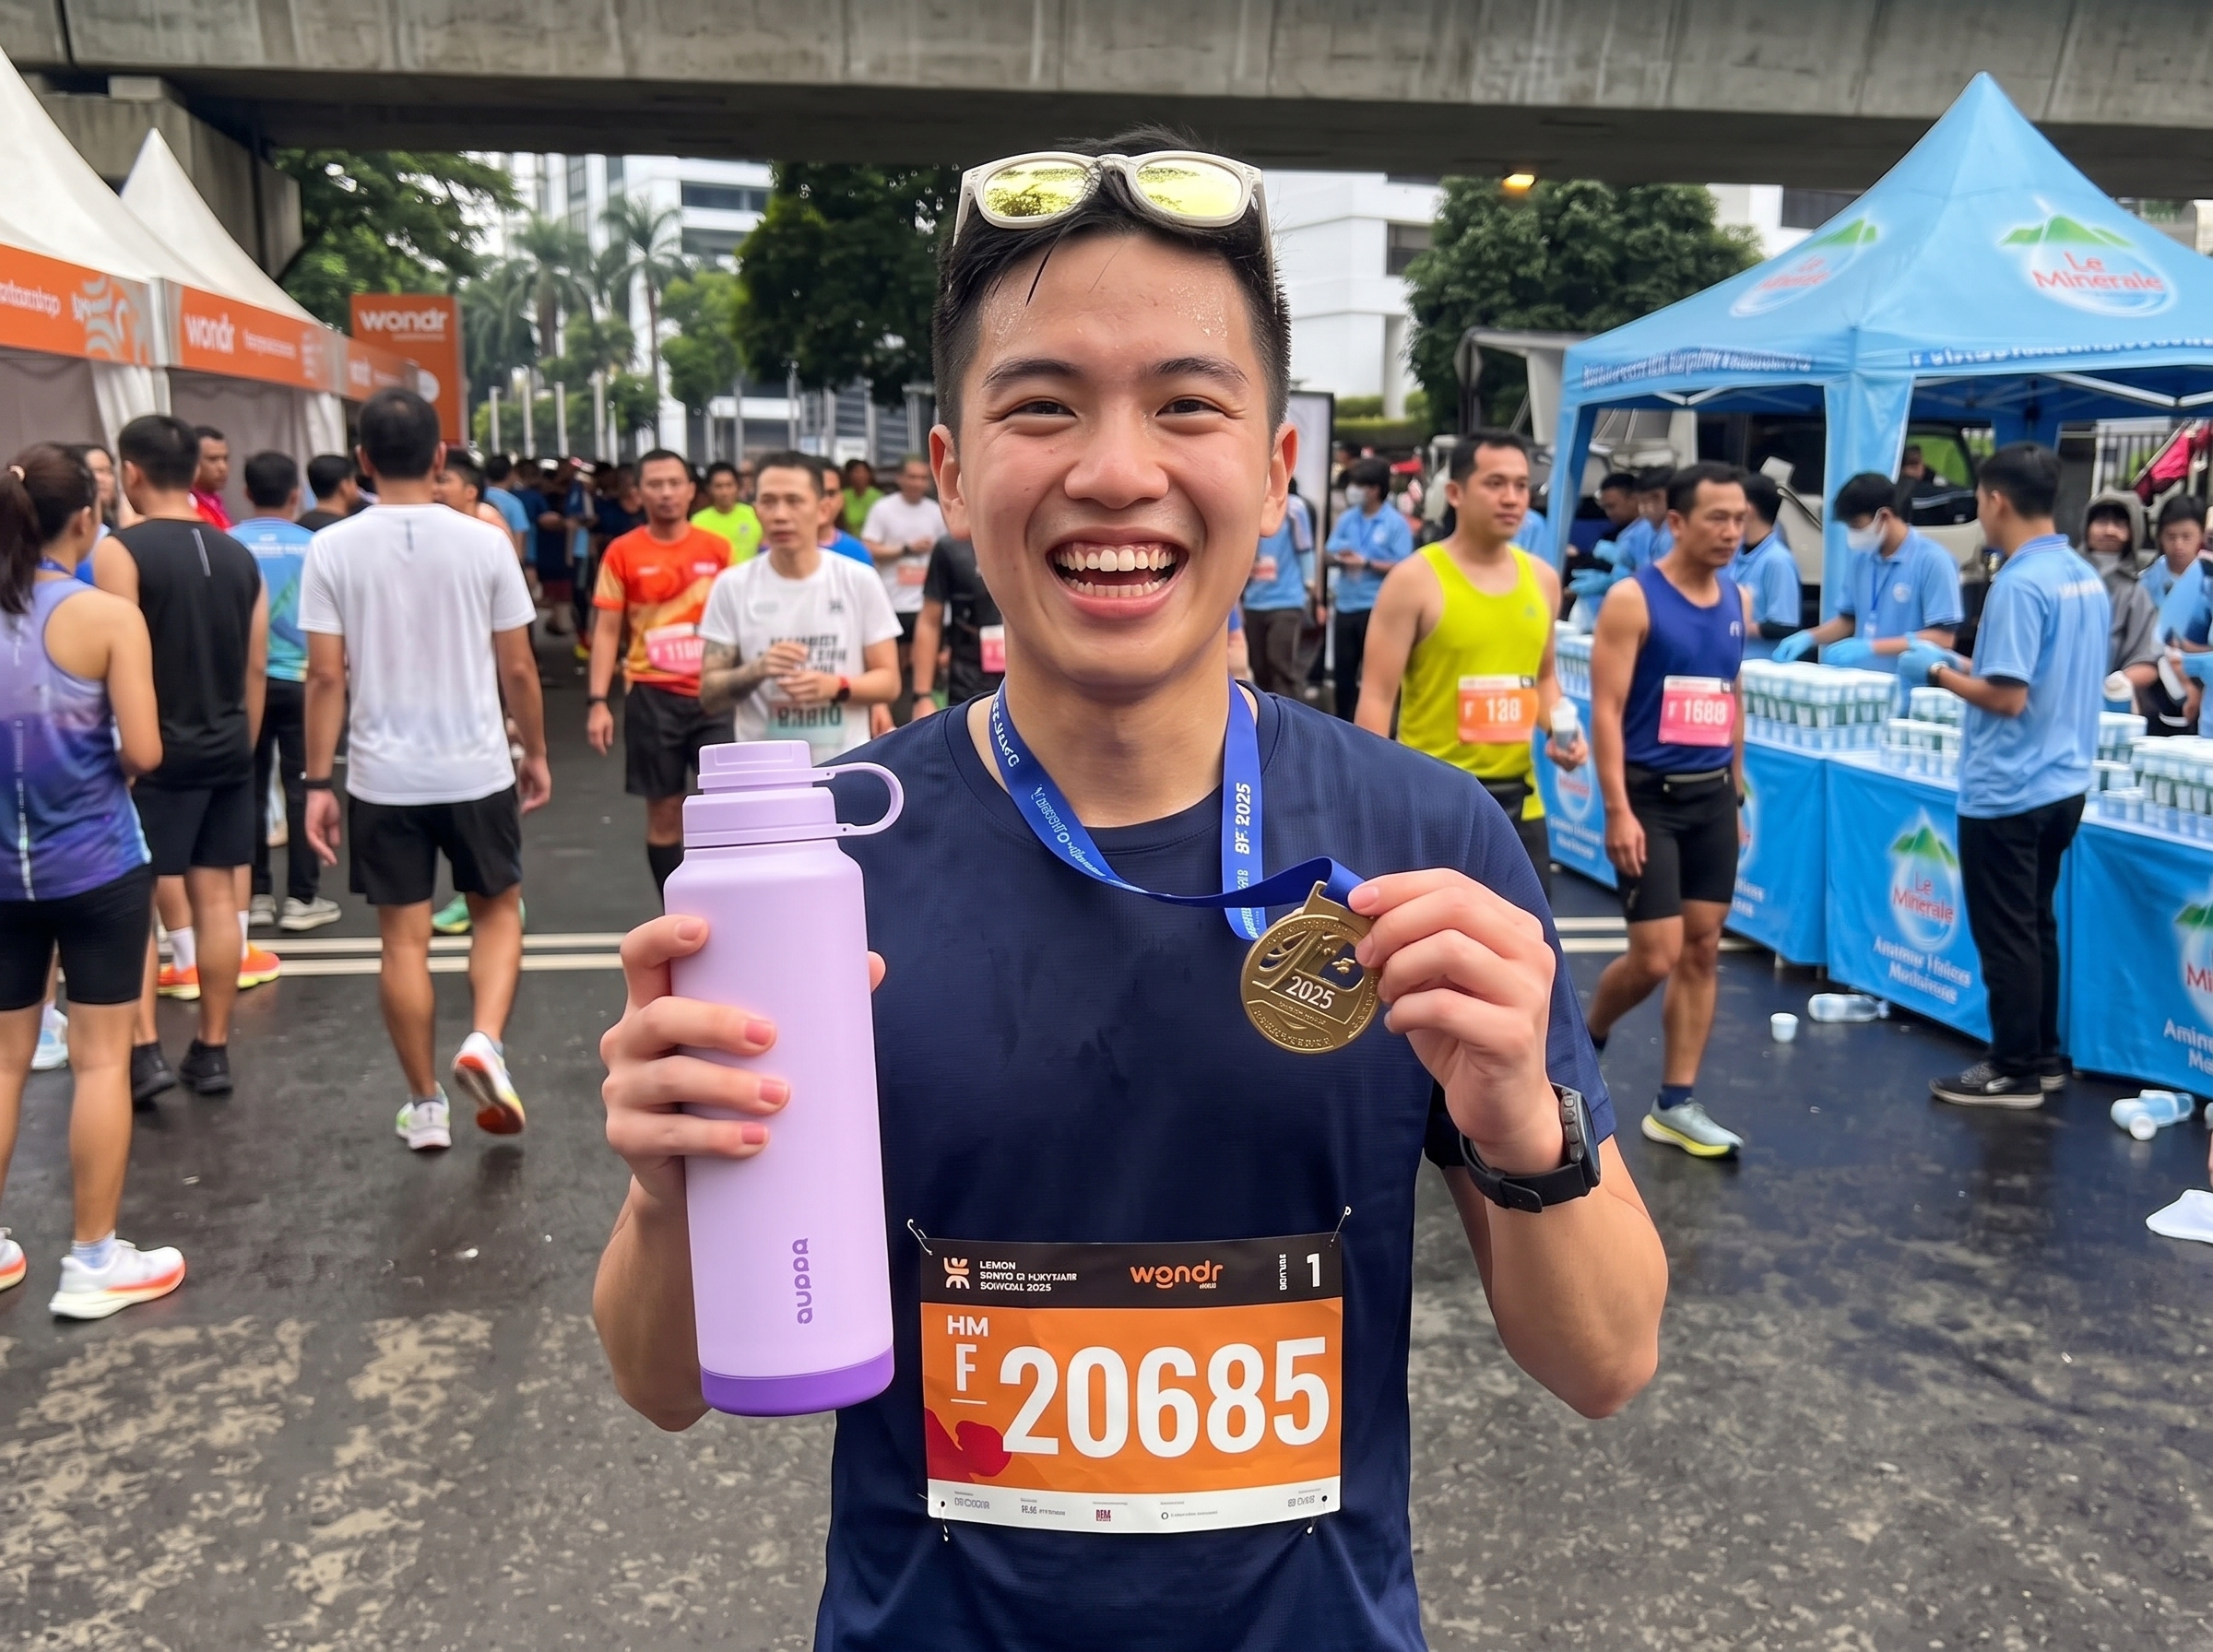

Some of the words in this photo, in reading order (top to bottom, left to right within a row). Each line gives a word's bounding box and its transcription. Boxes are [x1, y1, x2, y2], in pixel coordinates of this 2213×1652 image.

[2064, 251, 2104, 272] Le
[2033, 270, 2163, 291] Minerale
[358, 307, 449, 332] wondr
[1236, 783, 1250, 827] 2025
[1915, 870, 1932, 895] Le
[1893, 887, 1954, 924] Minerale
[1285, 975, 1336, 1009] 2025
[979, 1260, 1016, 1270] LEMON
[1130, 1259, 1224, 1285] wondr
[1307, 1253, 1320, 1288] 1
[1026, 1283, 1052, 1292] 2025
[947, 1315, 988, 1337] HM
[955, 1343, 977, 1392] F
[1000, 1336, 1331, 1458] 20685
